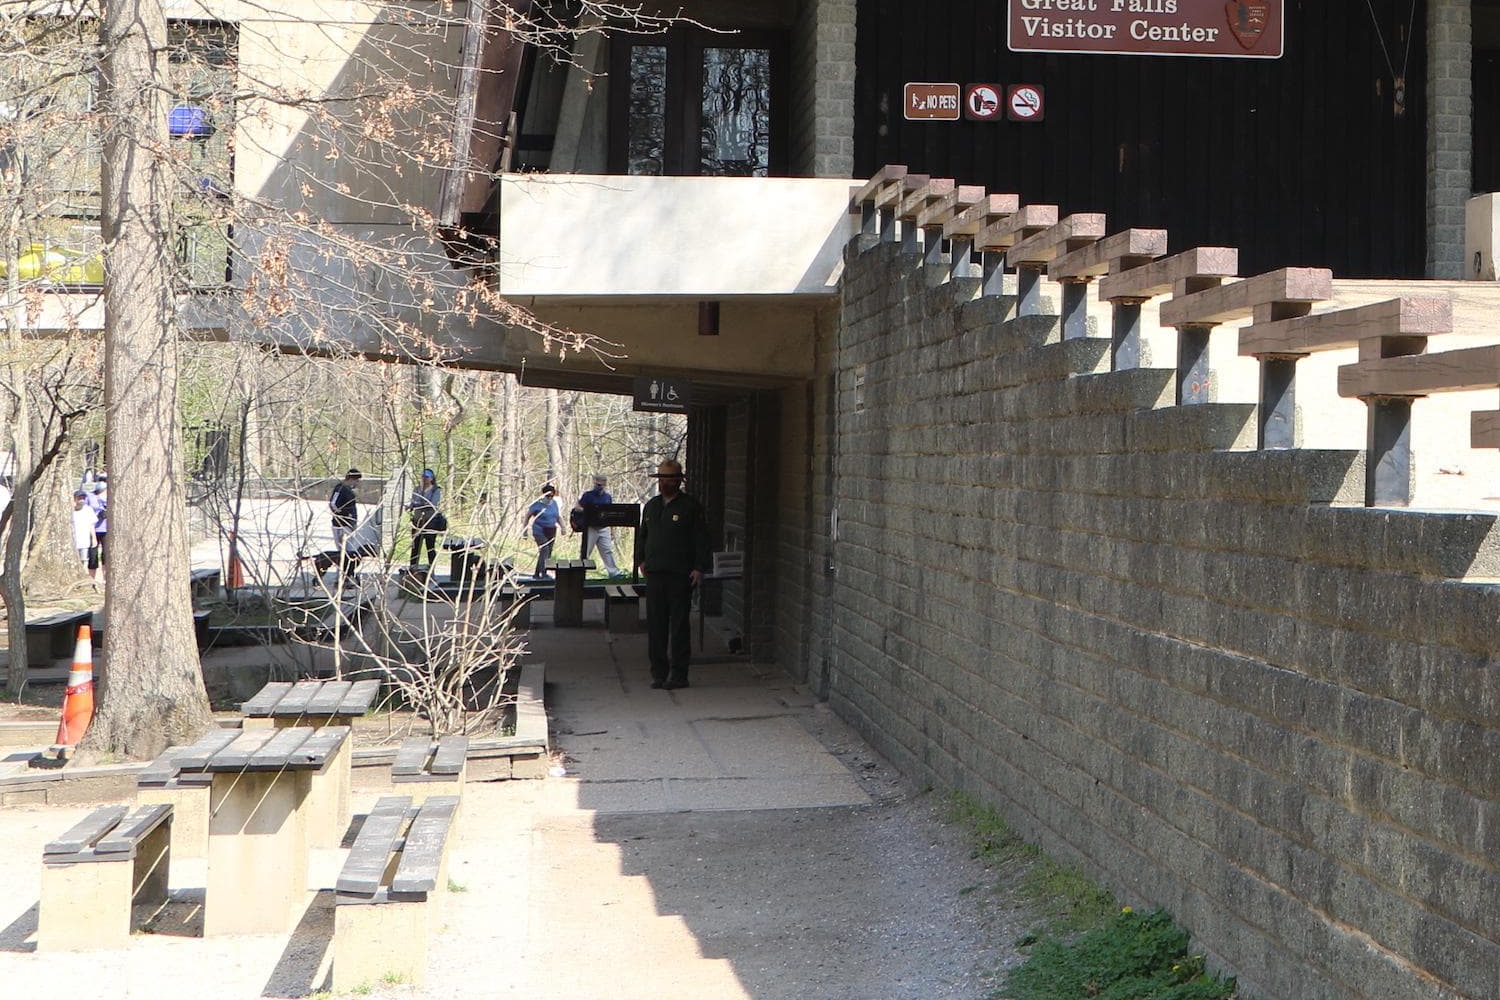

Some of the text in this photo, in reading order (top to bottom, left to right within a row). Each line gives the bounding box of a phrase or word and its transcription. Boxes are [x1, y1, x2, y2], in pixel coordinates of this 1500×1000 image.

[1021, 16, 1219, 43] Visitor Center
[927, 95, 957, 109] NO PETS
